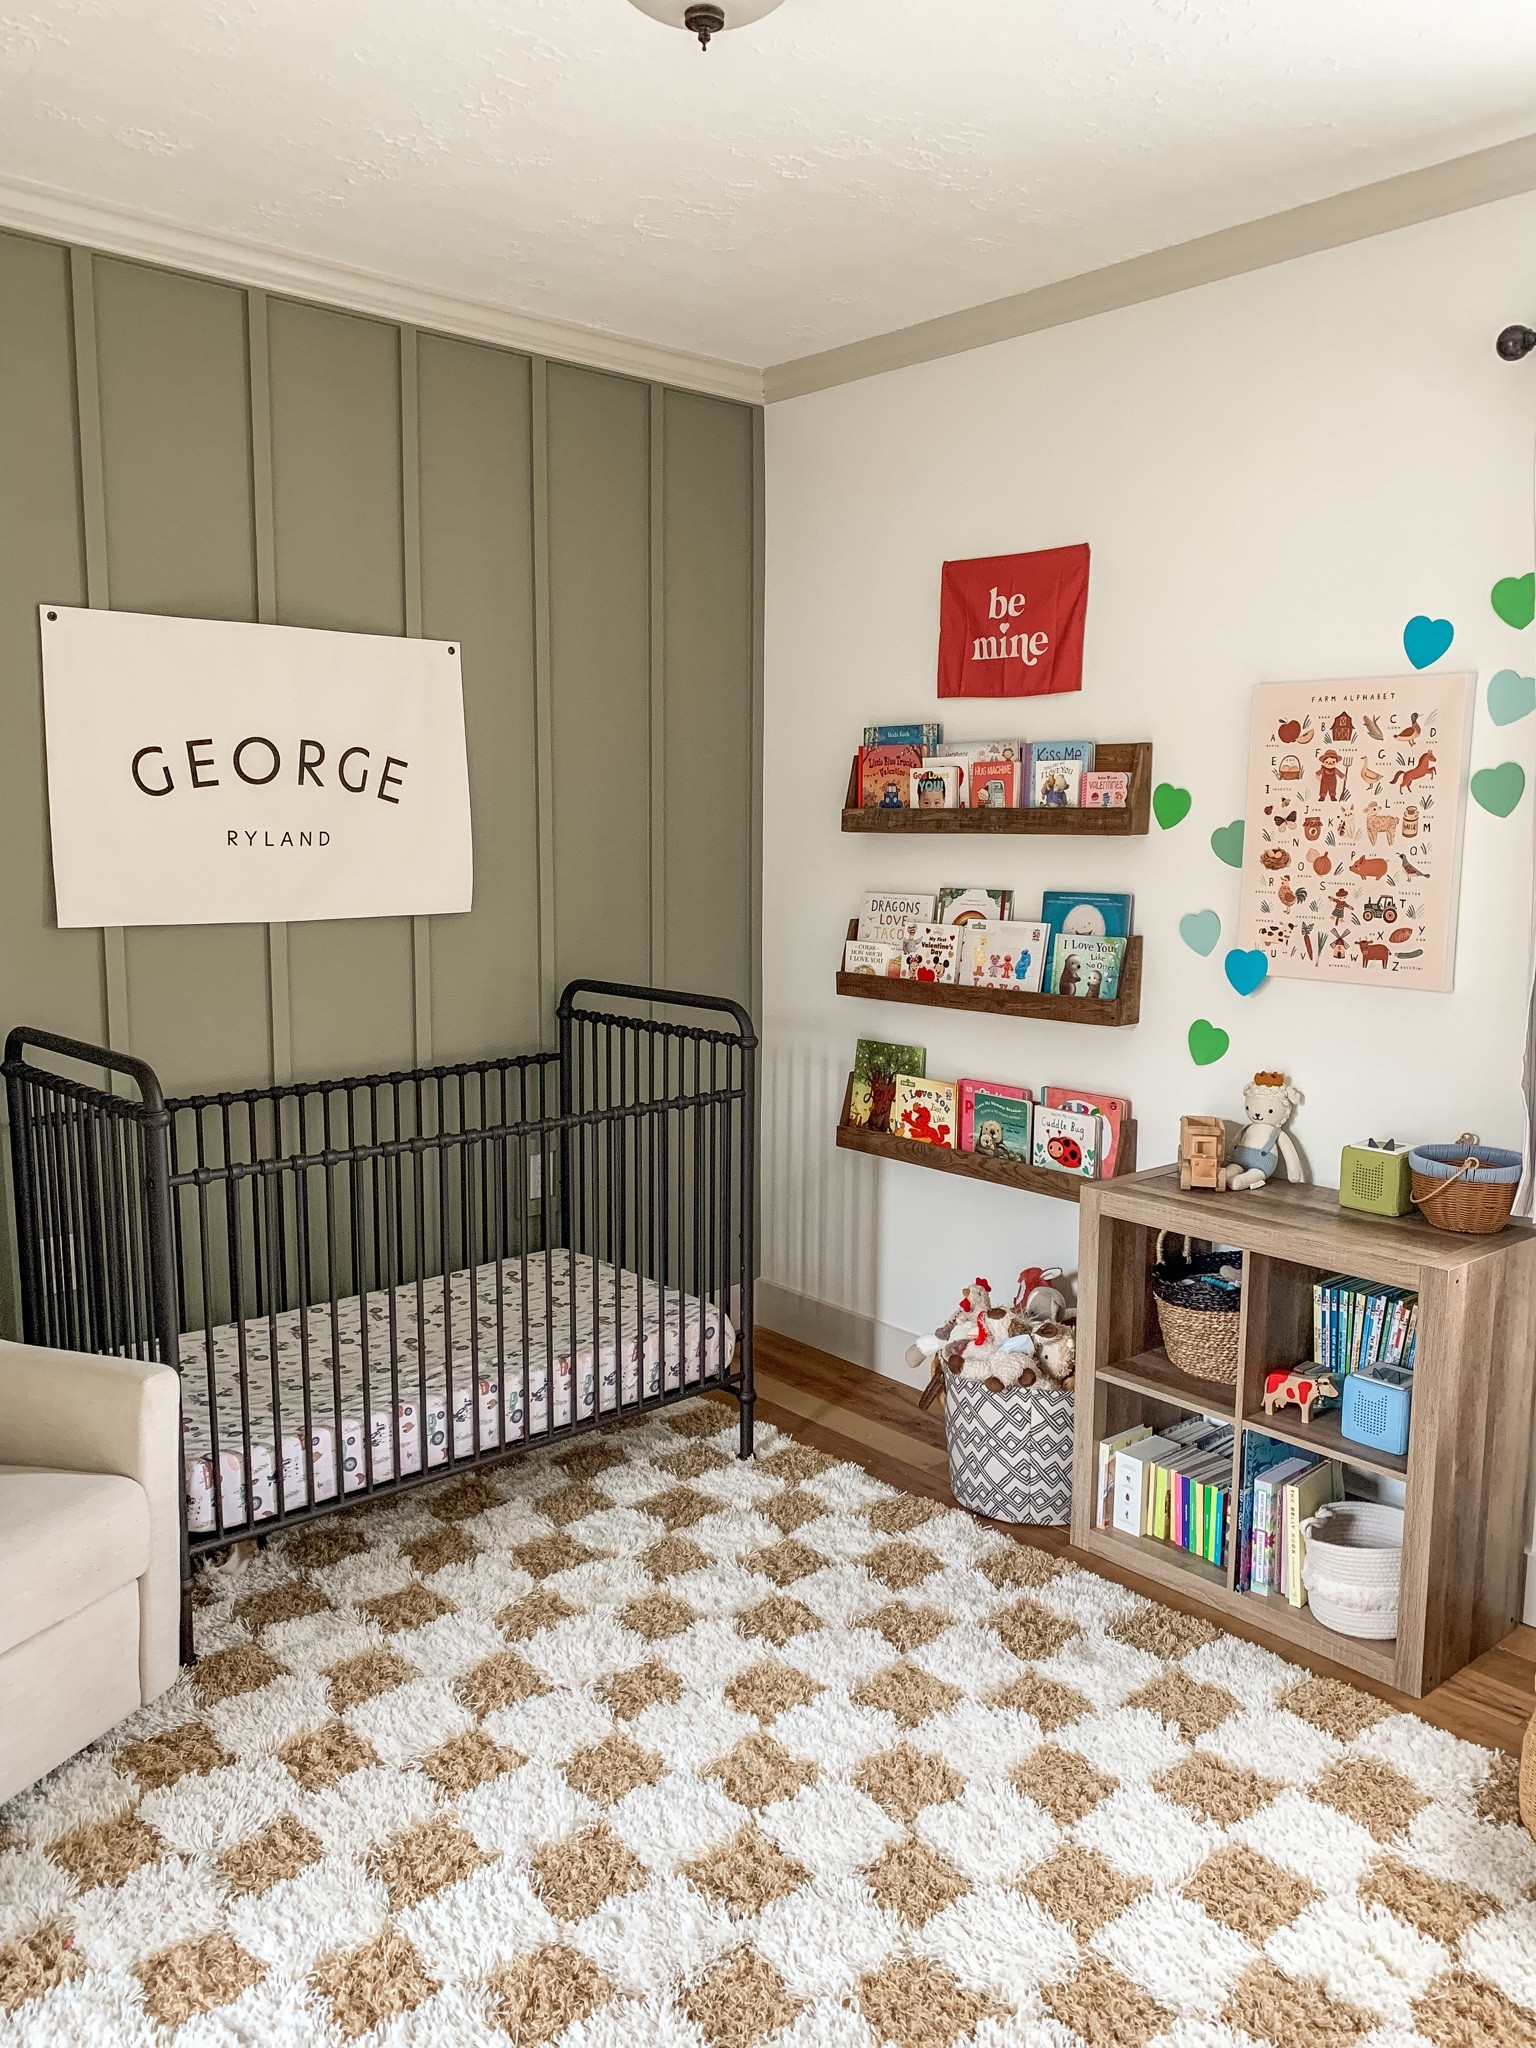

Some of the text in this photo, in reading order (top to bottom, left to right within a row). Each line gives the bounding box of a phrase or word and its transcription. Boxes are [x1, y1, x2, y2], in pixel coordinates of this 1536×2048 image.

[988, 586, 1026, 620] be
[971, 623, 1049, 666] mine
[1311, 692, 1396, 703] FARM ALPHABET
[1390, 714, 1397, 724] C
[1321, 722, 1326, 732] B
[1430, 727, 1437, 738] D
[1270, 734, 1276, 742] A
[1037, 747, 1082, 760] Kiss Me
[1315, 748, 1321, 757] F
[1377, 749, 1386, 759] G
[869, 757, 884, 769] Little
[884, 756, 897, 767] Blue
[1271, 757, 1277, 766] E
[1407, 757, 1415, 766] H
[131, 736, 409, 805] GEORGE
[974, 764, 1011, 776] HUG MACHINE
[1041, 766, 1074, 779] I LOVE YOU
[913, 771, 950, 780] God Loves
[919, 780, 944, 792] YOU!
[1089, 780, 1124, 790] VALENTINES
[1265, 784, 1270, 794] I
[1385, 799, 1391, 808] L
[1304, 805, 1309, 814] J
[1328, 818, 1334, 827] K
[1423, 823, 1431, 833] M
[227, 830, 332, 847] RYLAND
[1293, 838, 1300, 847] N
[1351, 851, 1356, 860] P
[1410, 846, 1418, 856] Q
[1297, 862, 1305, 871] O
[1269, 877, 1274, 886] R
[1320, 881, 1326, 891] S
[871, 900, 920, 915] DRAGONS
[1400, 899, 1407, 909] T
[880, 914, 908, 926] LOVE
[874, 926, 904, 940] TACO
[1377, 931, 1385, 940] X
[1419, 926, 1426, 936] Y
[921, 942, 954, 950] Valentine's
[1064, 940, 1115, 953] I Love You
[930, 949, 942, 957] Day
[1271, 950, 1277, 958] U
[1301, 952, 1306, 960] V
[1350, 954, 1359, 962] W
[1391, 962, 1399, 971] Z
[902, 1093, 908, 1103] I
[935, 1092, 951, 1114] You
[930, 1103, 942, 1114] Just
[932, 1115, 946, 1123] Like
[1041, 1117, 1067, 1130] Cuddle
[1071, 1122, 1085, 1141] Bug
